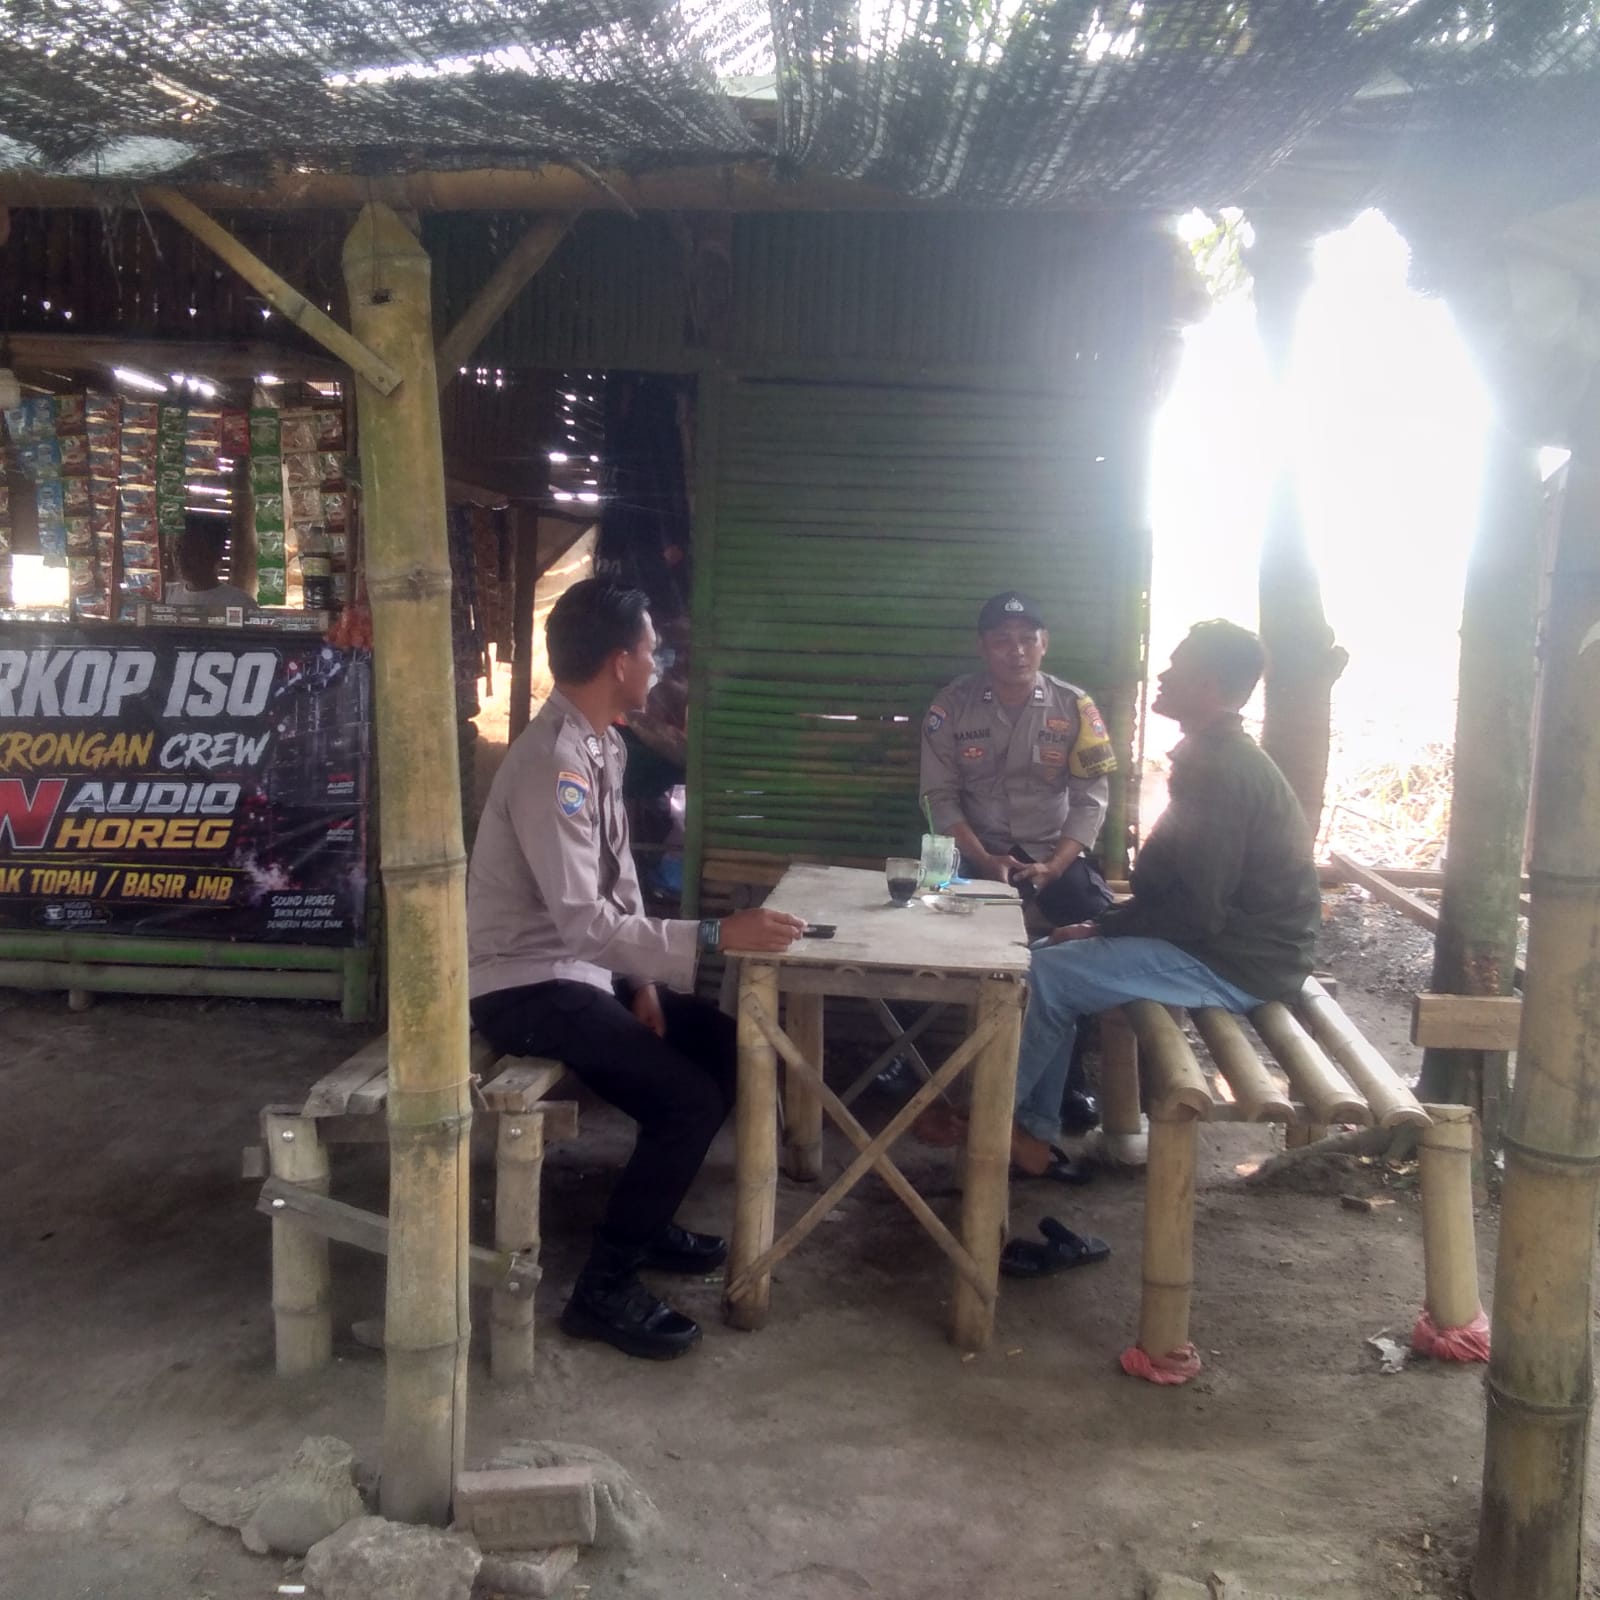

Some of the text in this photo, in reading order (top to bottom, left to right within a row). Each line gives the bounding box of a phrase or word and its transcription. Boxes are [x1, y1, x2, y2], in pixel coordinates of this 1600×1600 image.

[0, 650, 278, 717] RKOP ISO
[160, 730, 271, 769] CREW
[66, 782, 241, 814] AUDIO
[55, 818, 234, 849] HOREG
[31, 869, 97, 895] TOPAH
[121, 873, 187, 898] BASIR
[189, 875, 234, 900] JMB
[271, 894, 336, 907] SOUND HOREG
